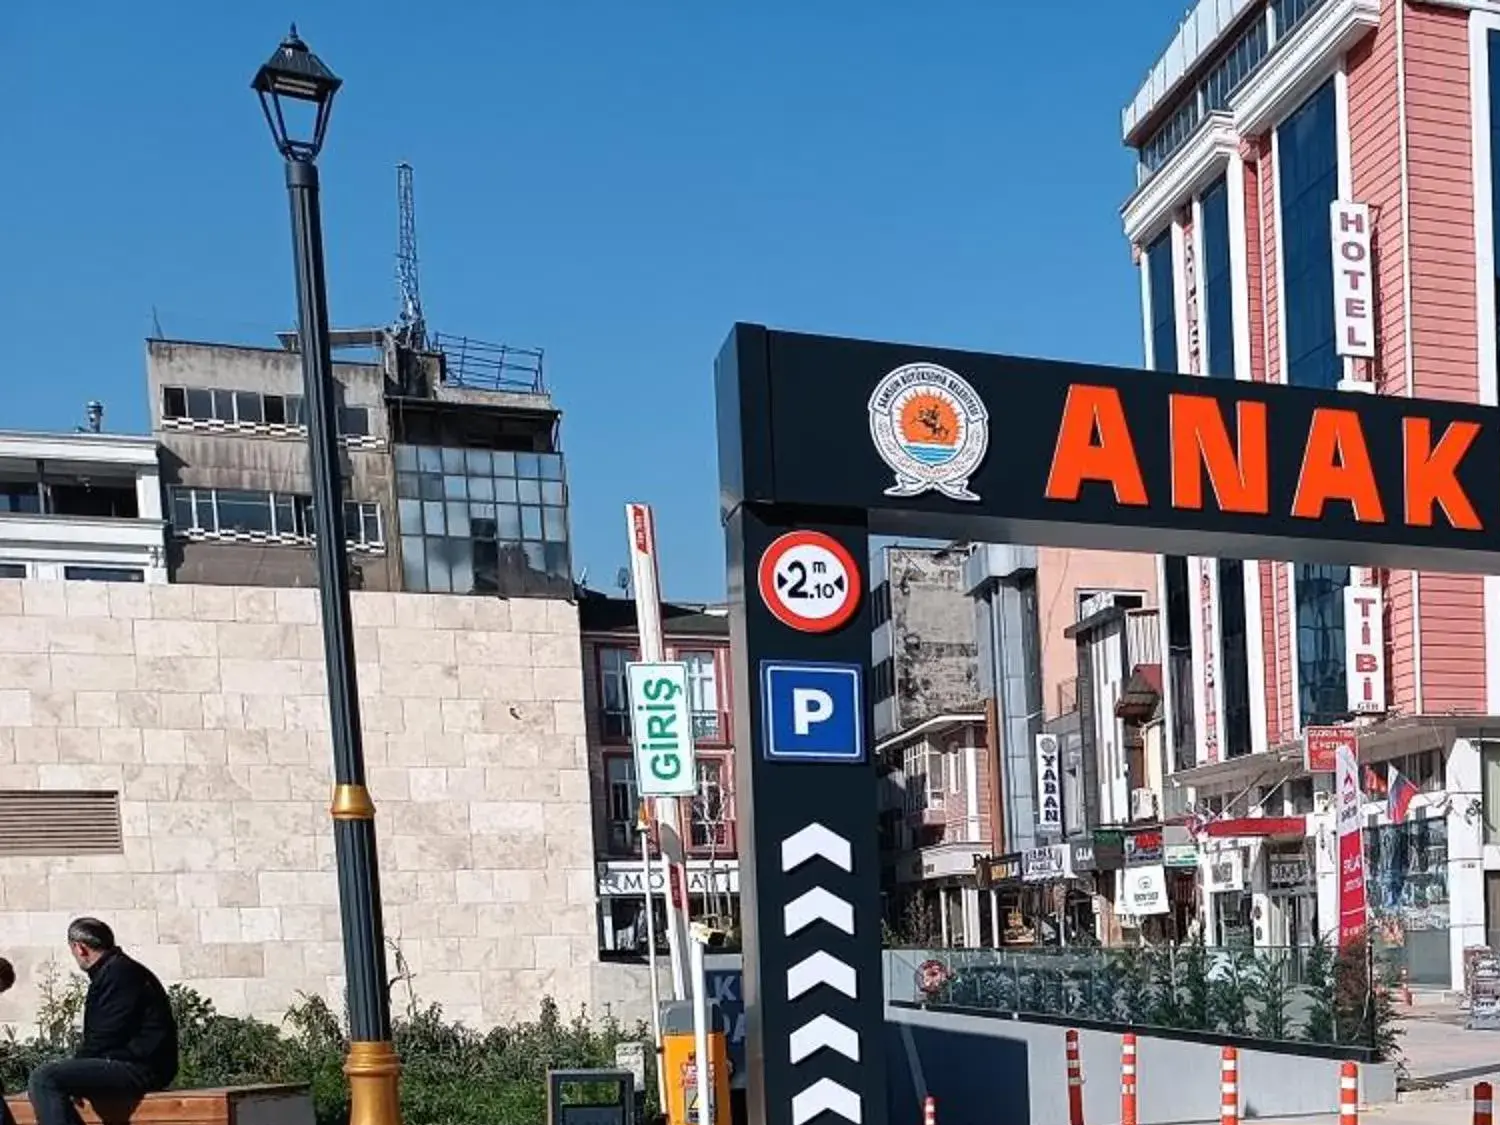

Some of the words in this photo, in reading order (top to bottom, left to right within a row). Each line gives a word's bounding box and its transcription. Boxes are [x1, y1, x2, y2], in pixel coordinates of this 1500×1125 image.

[1340, 211, 1367, 347] HOTEL
[1353, 597, 1378, 701] TİBİ
[637, 677, 683, 780] GİRİŞ
[793, 687, 834, 736] P
[1041, 755, 1059, 822] YABAN
